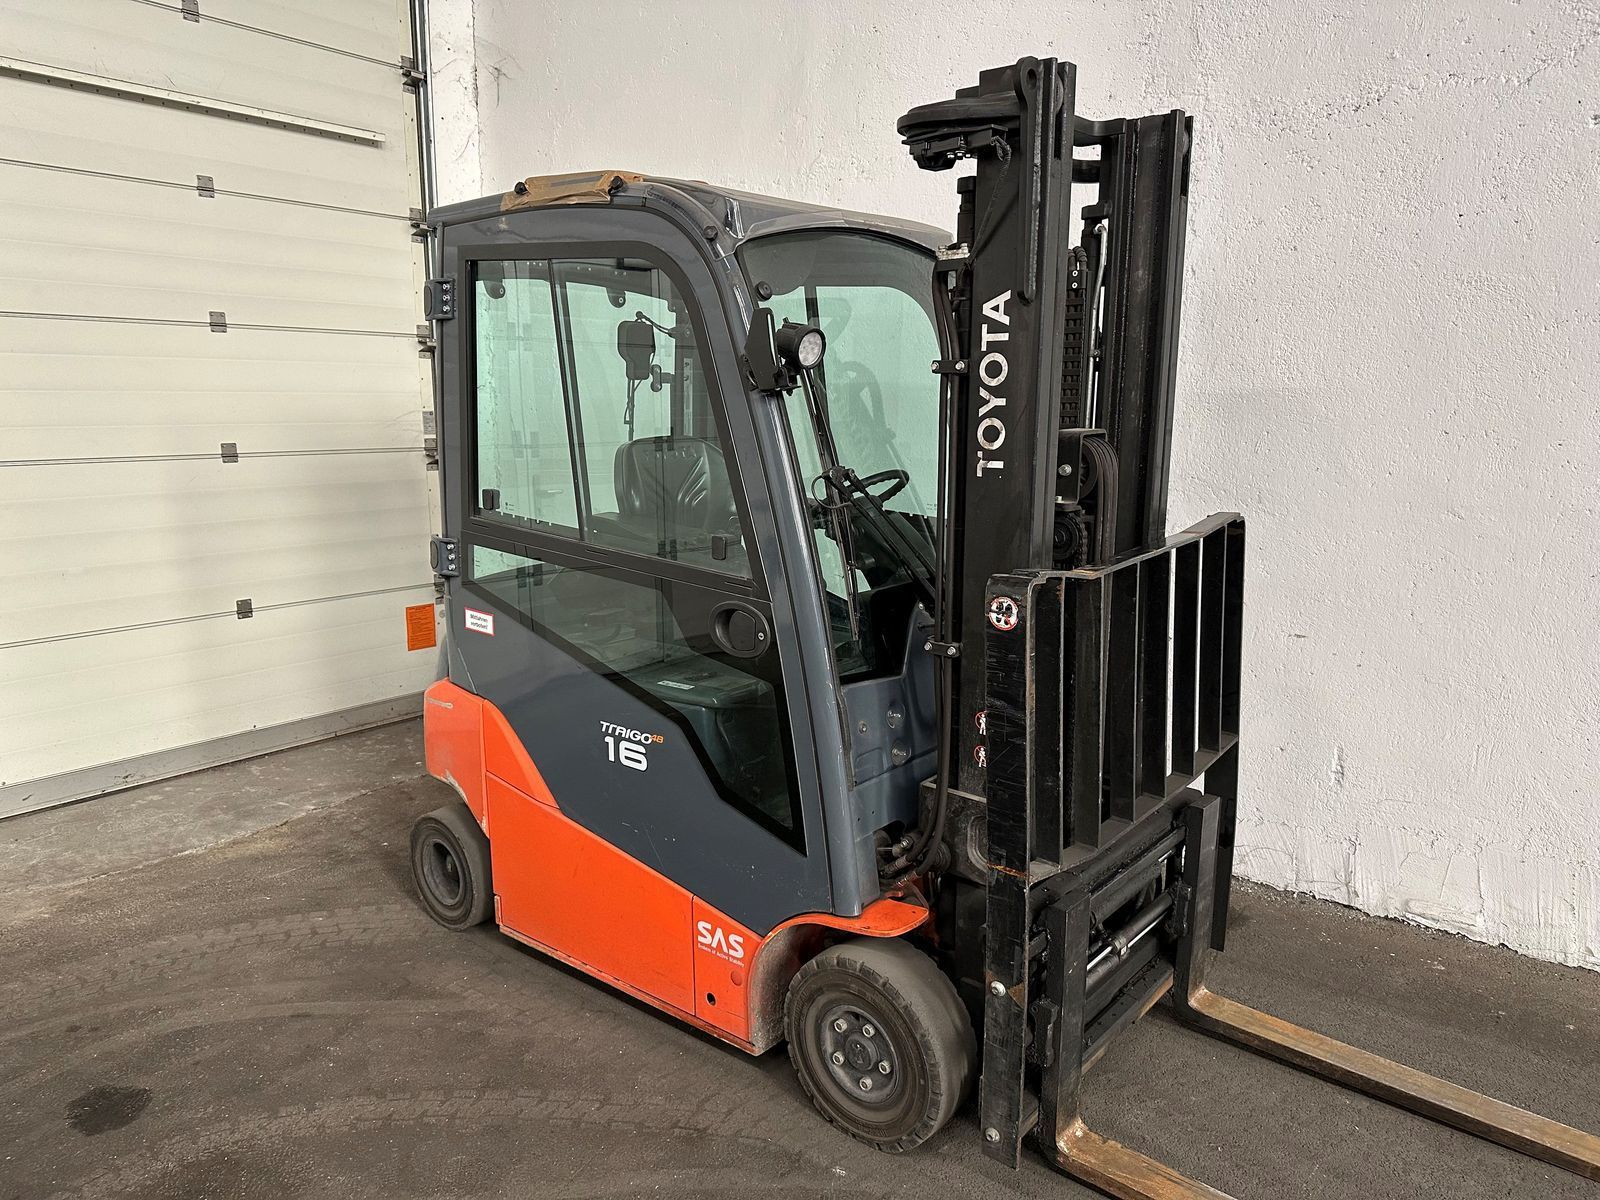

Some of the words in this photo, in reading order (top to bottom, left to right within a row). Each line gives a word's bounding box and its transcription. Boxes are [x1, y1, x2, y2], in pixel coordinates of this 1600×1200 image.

[976, 289, 1012, 478] TOYOTA
[604, 735, 648, 772] 16
[697, 920, 745, 959] SAS
